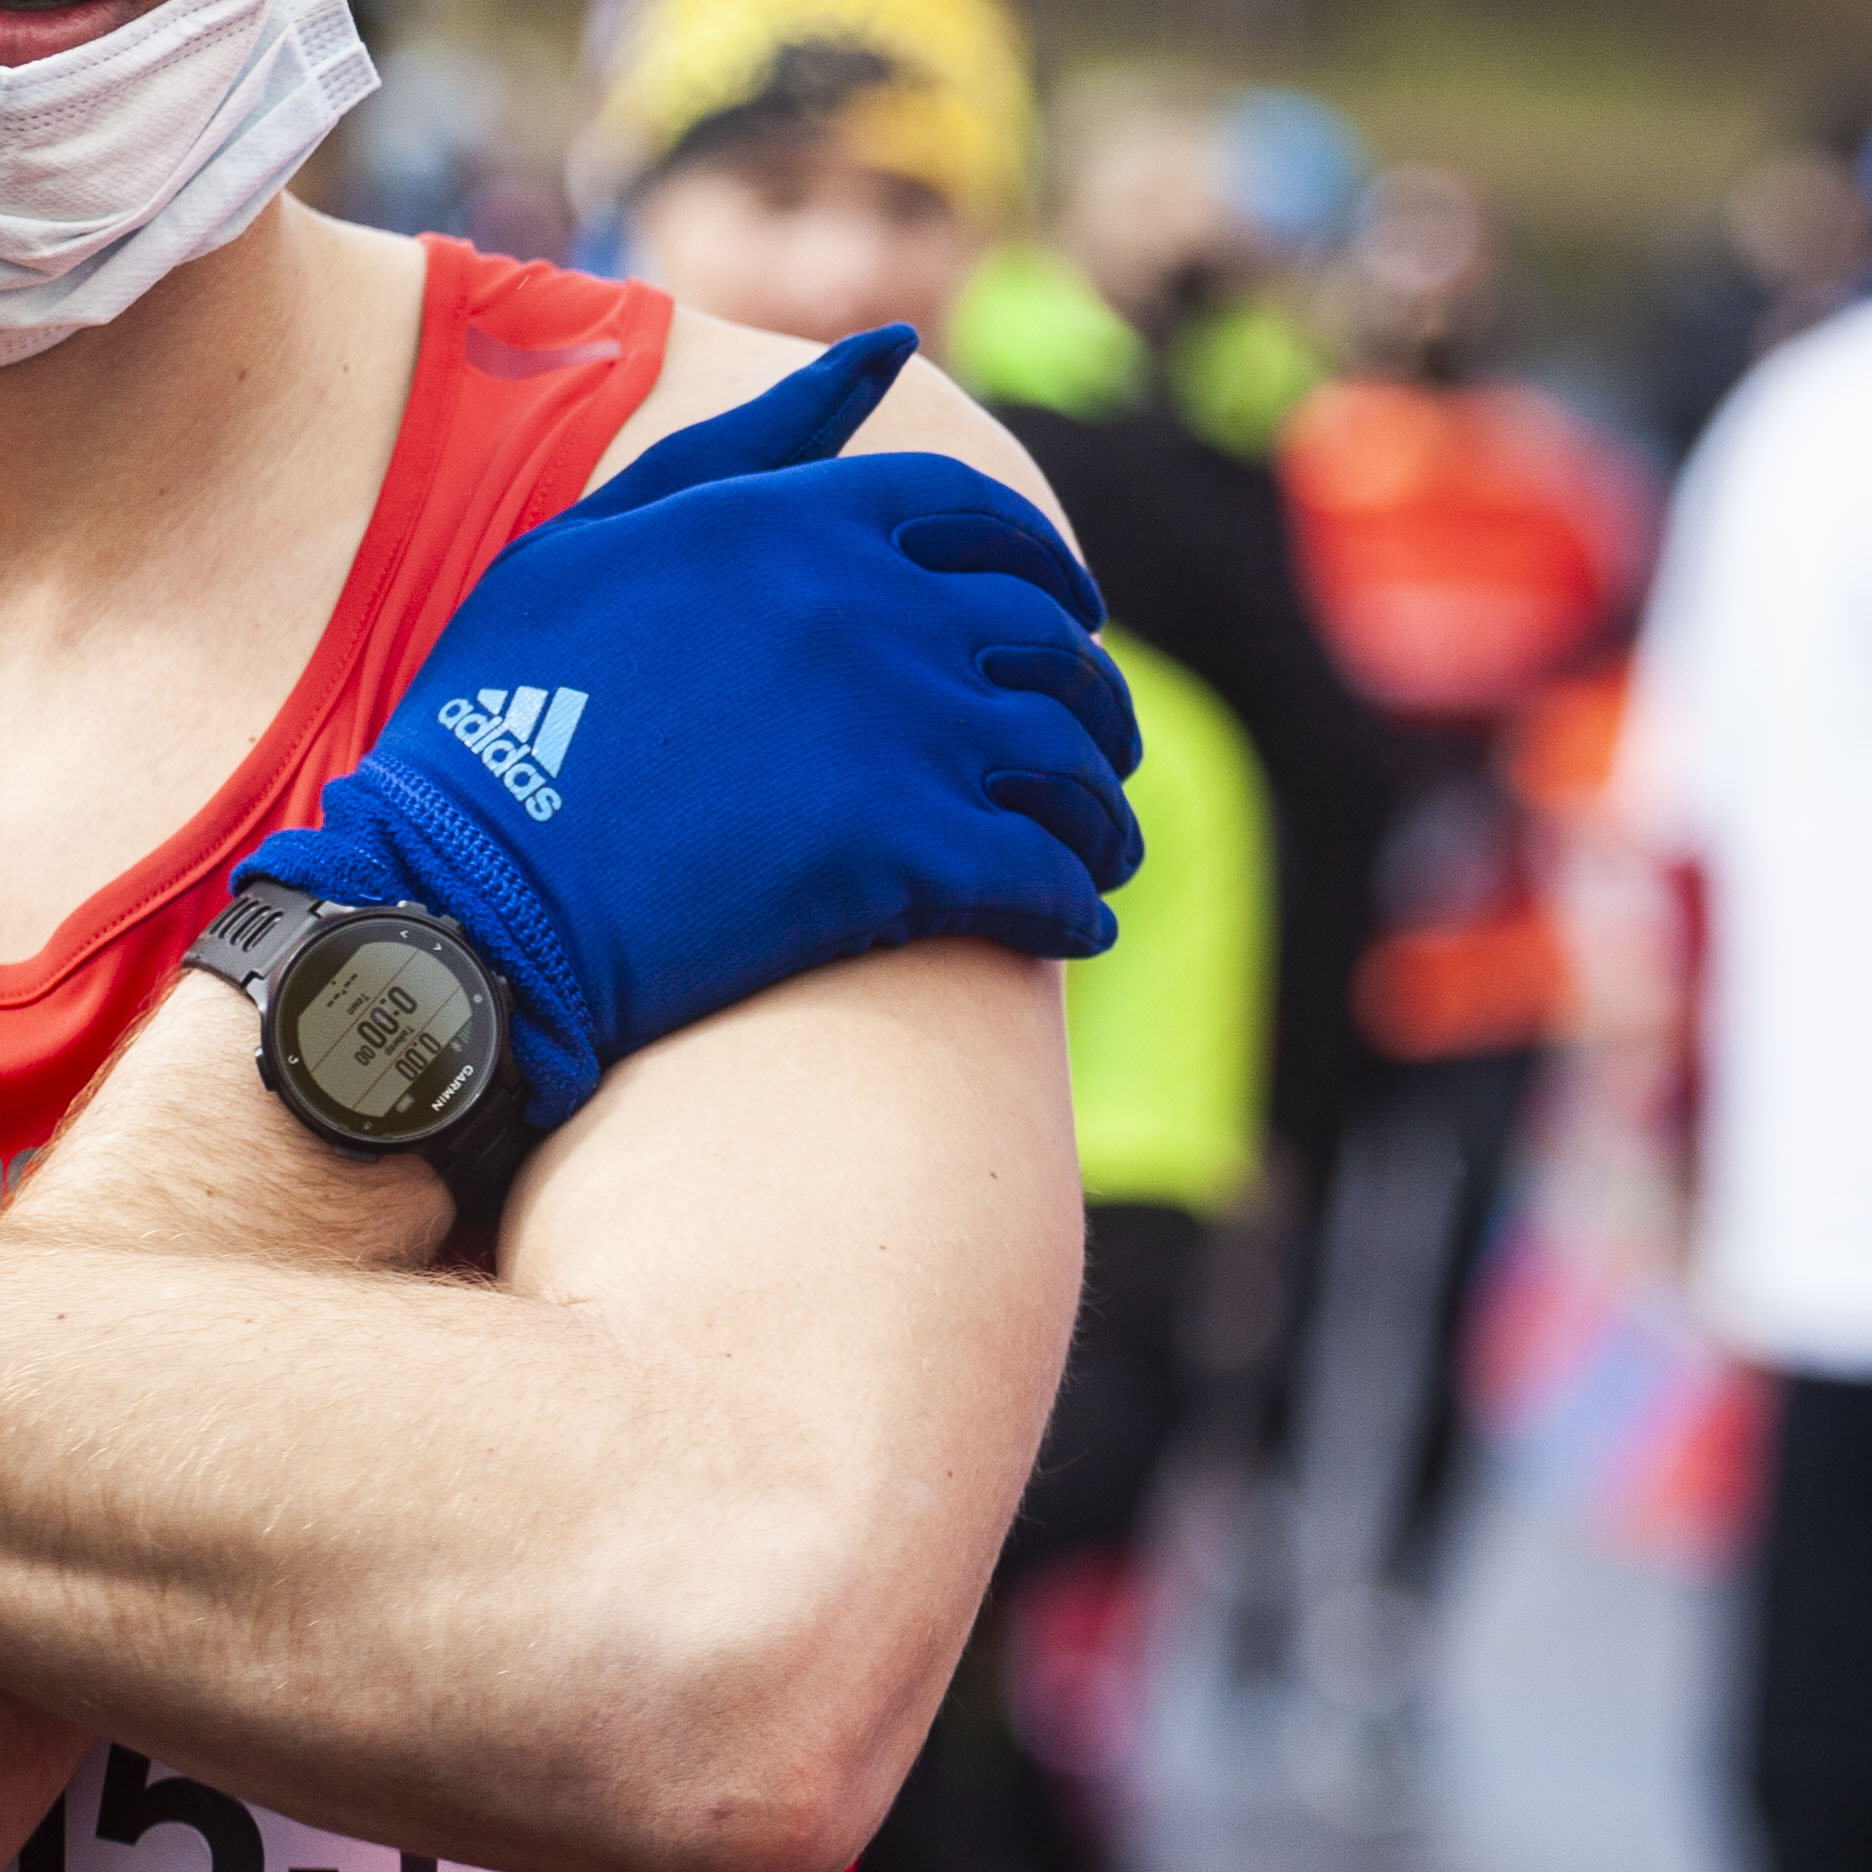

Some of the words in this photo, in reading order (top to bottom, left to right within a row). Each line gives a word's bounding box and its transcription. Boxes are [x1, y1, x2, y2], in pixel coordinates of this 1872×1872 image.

[437, 697, 563, 823] adidas
[395, 1032, 442, 1081] 0.00
[431, 1064, 474, 1112] GARMIN
